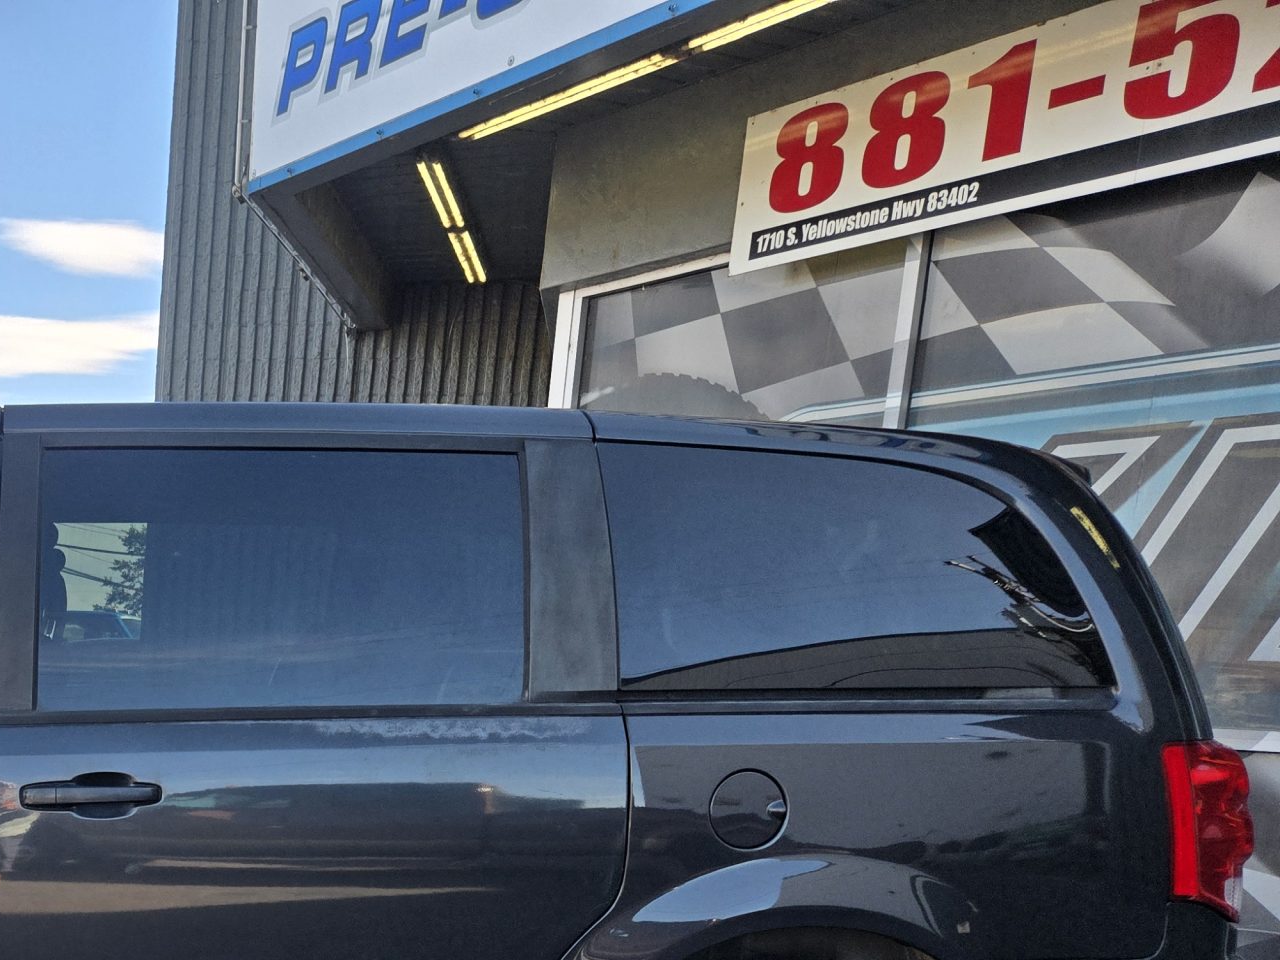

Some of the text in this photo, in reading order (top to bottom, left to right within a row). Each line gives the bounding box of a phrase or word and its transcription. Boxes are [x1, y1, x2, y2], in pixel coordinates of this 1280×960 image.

[756, 181, 980, 254] 1710 S. Yellowstone Hwy 83402
